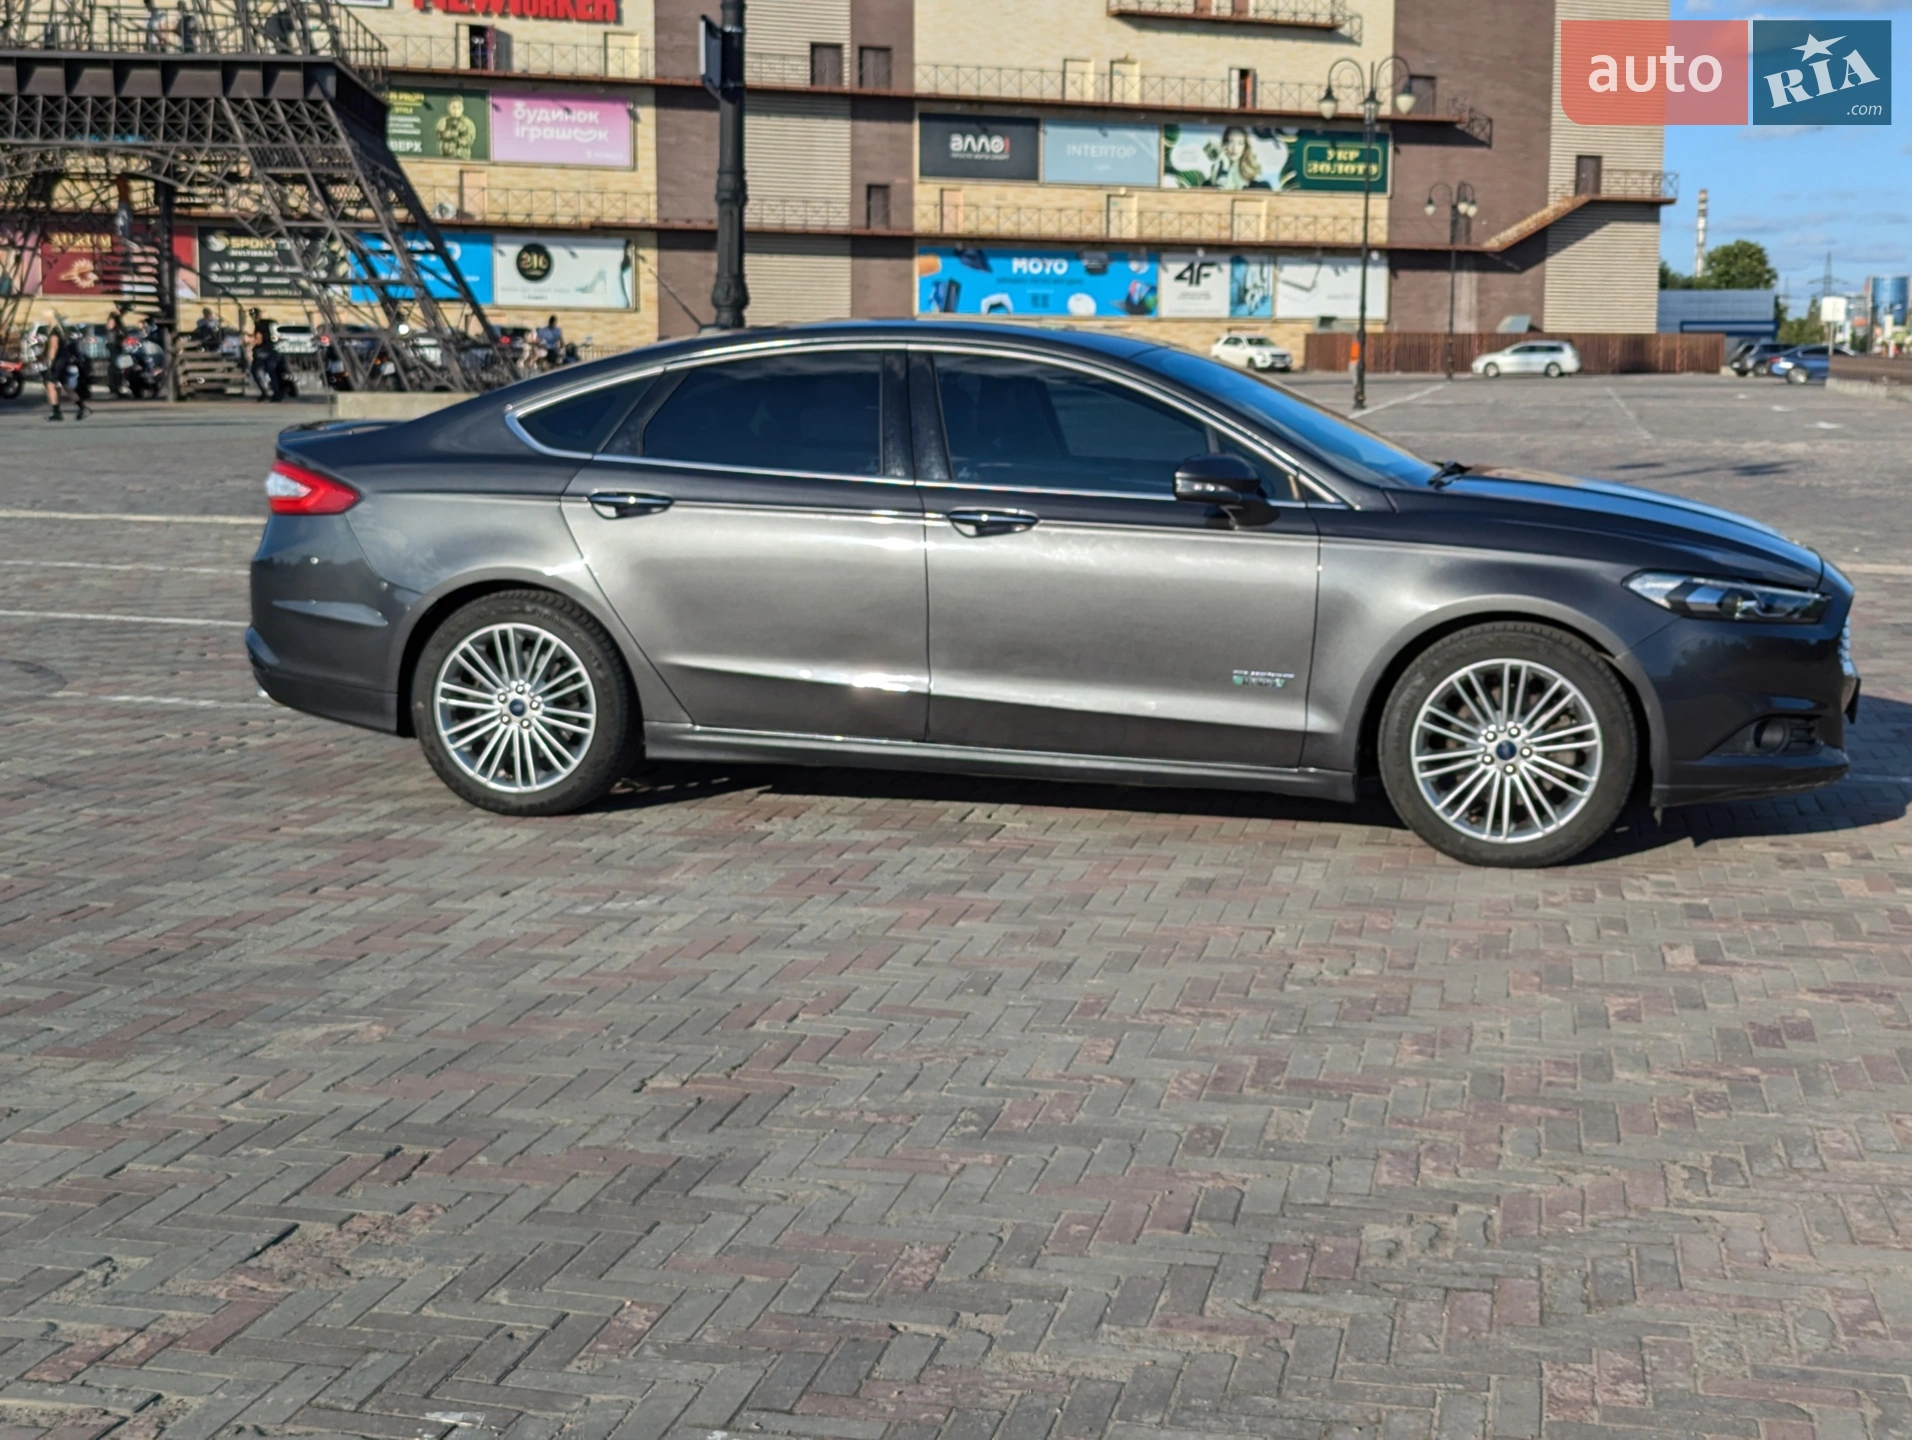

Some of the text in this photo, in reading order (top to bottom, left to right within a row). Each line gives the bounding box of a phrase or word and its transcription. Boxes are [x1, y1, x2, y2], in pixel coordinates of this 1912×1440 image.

[1066, 144, 1137, 159] INTERTOP
[1326, 149, 1360, 161] УКР
[1012, 257, 1068, 275] MOYO
[1174, 261, 1218, 287] 4F
